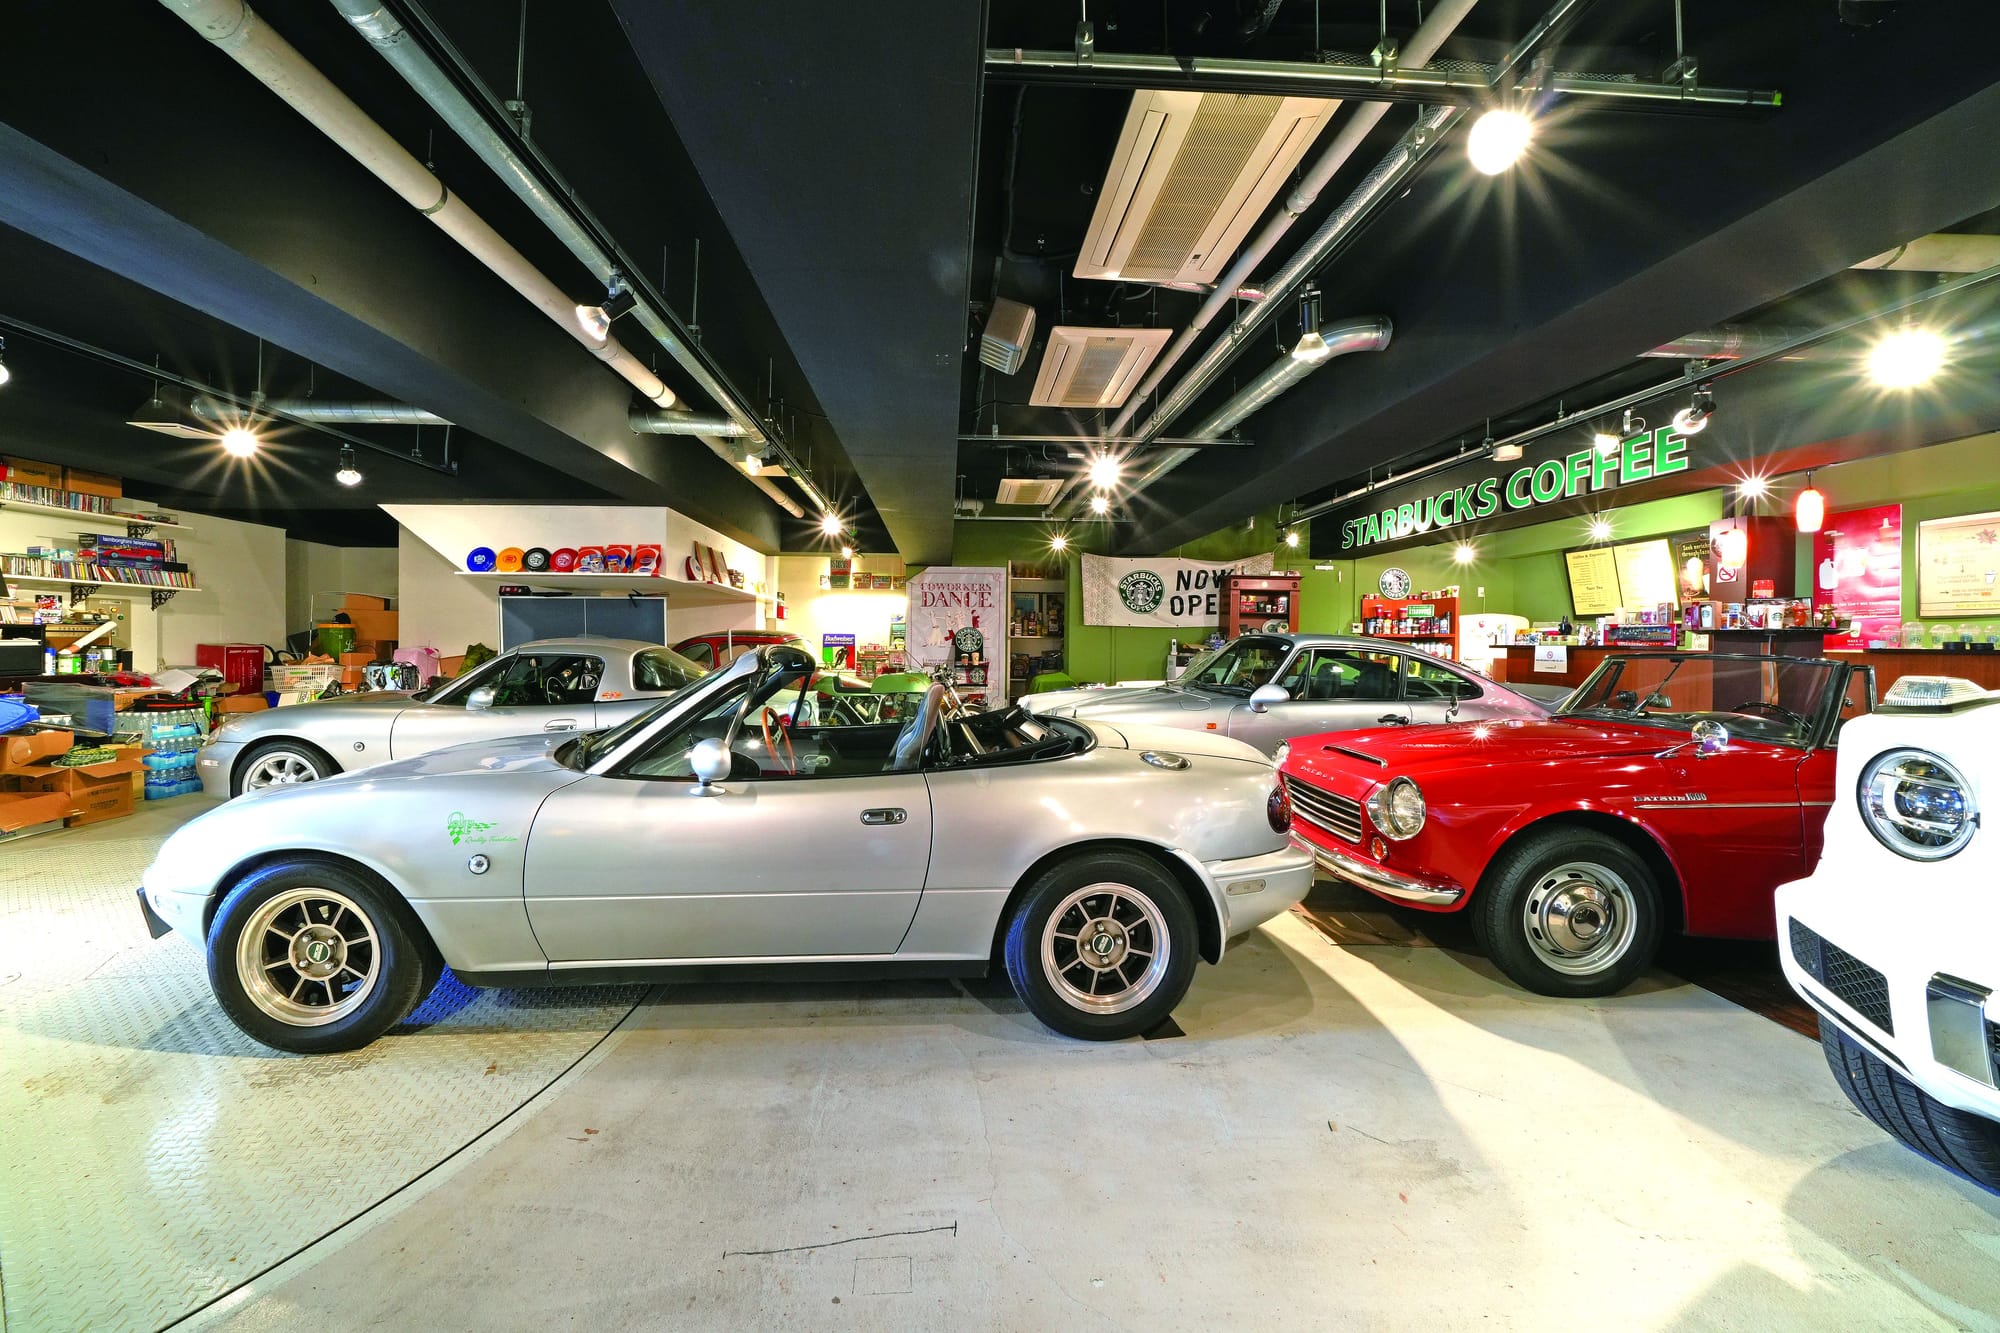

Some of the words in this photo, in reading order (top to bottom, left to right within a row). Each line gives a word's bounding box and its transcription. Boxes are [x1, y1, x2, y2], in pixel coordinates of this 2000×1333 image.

[1341, 477, 1498, 550] STARBUCKS
[1504, 425, 1688, 508] COFFEE
[920, 583, 992, 592] COWORKERS
[1120, 572, 1162, 592] STARBUCKS
[920, 591, 992, 608] DANCE
[1126, 599, 1157, 612] COFFEE
[1169, 593, 1218, 617] OPE
